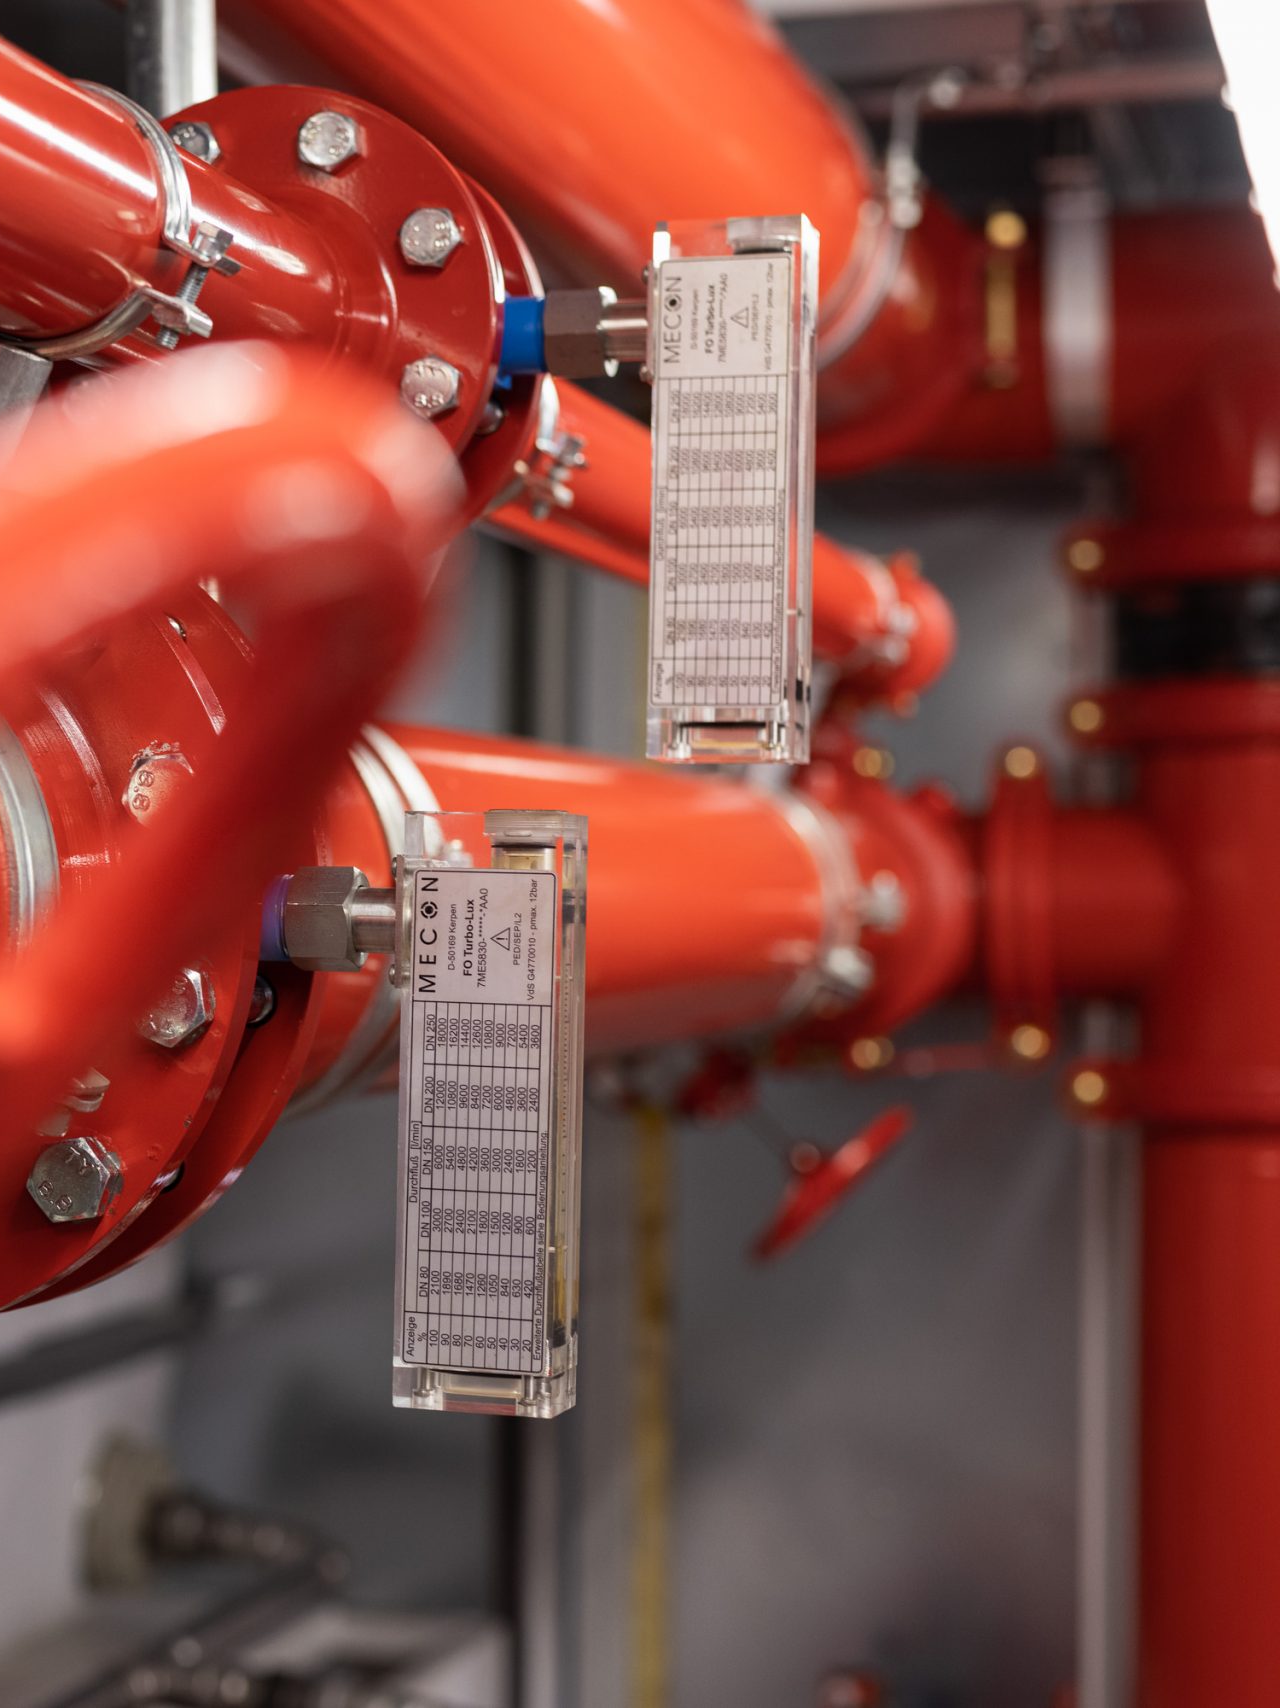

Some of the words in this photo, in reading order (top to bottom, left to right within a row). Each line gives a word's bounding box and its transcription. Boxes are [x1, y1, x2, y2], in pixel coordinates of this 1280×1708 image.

[663, 277, 682, 363] MECON
[131, 769, 155, 812] 8.8
[448, 904, 457, 933] Kerpen
[464, 899, 474, 956] Turbo-Lux
[419, 878, 438, 993] MECON
[513, 913, 522, 965] PED/SEP/L2
[448, 936, 456, 970] D-50169
[528, 938, 536, 980] G4770010
[464, 960, 473, 976] FO
[527, 984, 535, 1000] VdS
[427, 1014, 435, 1030] 250
[438, 1018, 446, 1047] 18000
[449, 1018, 458, 1048] 16200
[461, 1019, 470, 1048] 14400
[472, 1019, 481, 1048] 12600
[426, 1032, 434, 1051] DN
[484, 1020, 493, 1049] 10800
[496, 1023, 505, 1048] 9000
[508, 1024, 516, 1048] 7200
[519, 1024, 528, 1048] 5400
[531, 1025, 540, 1049] 3600
[425, 1077, 434, 1093] 200
[436, 1080, 445, 1109] 12000
[448, 1081, 457, 1110] 10800
[459, 1085, 468, 1109] 9600
[425, 1095, 433, 1113] DN
[471, 1085, 480, 1110] 8400
[482, 1085, 491, 1110] 7200
[494, 1086, 503, 1110] 6000
[506, 1087, 514, 1111] 4800
[518, 1087, 526, 1111] 3600
[529, 1088, 538, 1112] 2400
[424, 1138, 432, 1154] 150
[435, 1145, 443, 1169] 6000
[446, 1145, 455, 1170] 5400
[458, 1146, 466, 1170] 4800
[423, 1156, 431, 1175] DN
[469, 1147, 478, 1171] 4200
[481, 1148, 489, 1172] 3600
[492, 1148, 501, 1172] 3000
[504, 1149, 513, 1173] 2400
[516, 1149, 525, 1172] 1800
[528, 1150, 536, 1173] 1200
[409, 1155, 419, 1203] Durchfluß
[38, 1180, 73, 1212] 8.8
[422, 1201, 430, 1216] 100
[433, 1208, 441, 1232] 3000
[421, 1217, 429, 1237] DN
[444, 1209, 453, 1233] 2700
[456, 1209, 464, 1233] 2400
[467, 1210, 476, 1234] 2100
[479, 1211, 488, 1234] 1800
[491, 1211, 499, 1235] 1500
[502, 1212, 511, 1235] 1200
[514, 1216, 522, 1234] 900
[525, 1217, 534, 1235] 600
[536, 1223, 545, 1245] siehe
[420, 1266, 428, 1277] 80
[431, 1270, 440, 1295] 2100
[442, 1271, 451, 1295] 1890
[420, 1279, 428, 1297] DN
[454, 1272, 462, 1296] 1680
[466, 1273, 474, 1296] 1470
[478, 1274, 486, 1297] 1260
[489, 1274, 498, 1297] 1050
[501, 1278, 509, 1297] 840
[512, 1279, 521, 1297] 630
[524, 1280, 532, 1298] 420
[407, 1316, 418, 1356] Anzeige
[418, 1332, 427, 1342] %
[430, 1330, 438, 1347] 100
[441, 1334, 450, 1345] 90
[452, 1334, 461, 1346] 80
[464, 1335, 473, 1347] 70
[476, 1336, 485, 1348] 60
[487, 1337, 496, 1349] 50
[499, 1338, 508, 1350] 40
[511, 1338, 519, 1350] 30
[522, 1339, 531, 1352] 20
[533, 1318, 542, 1360] Erweiterte
